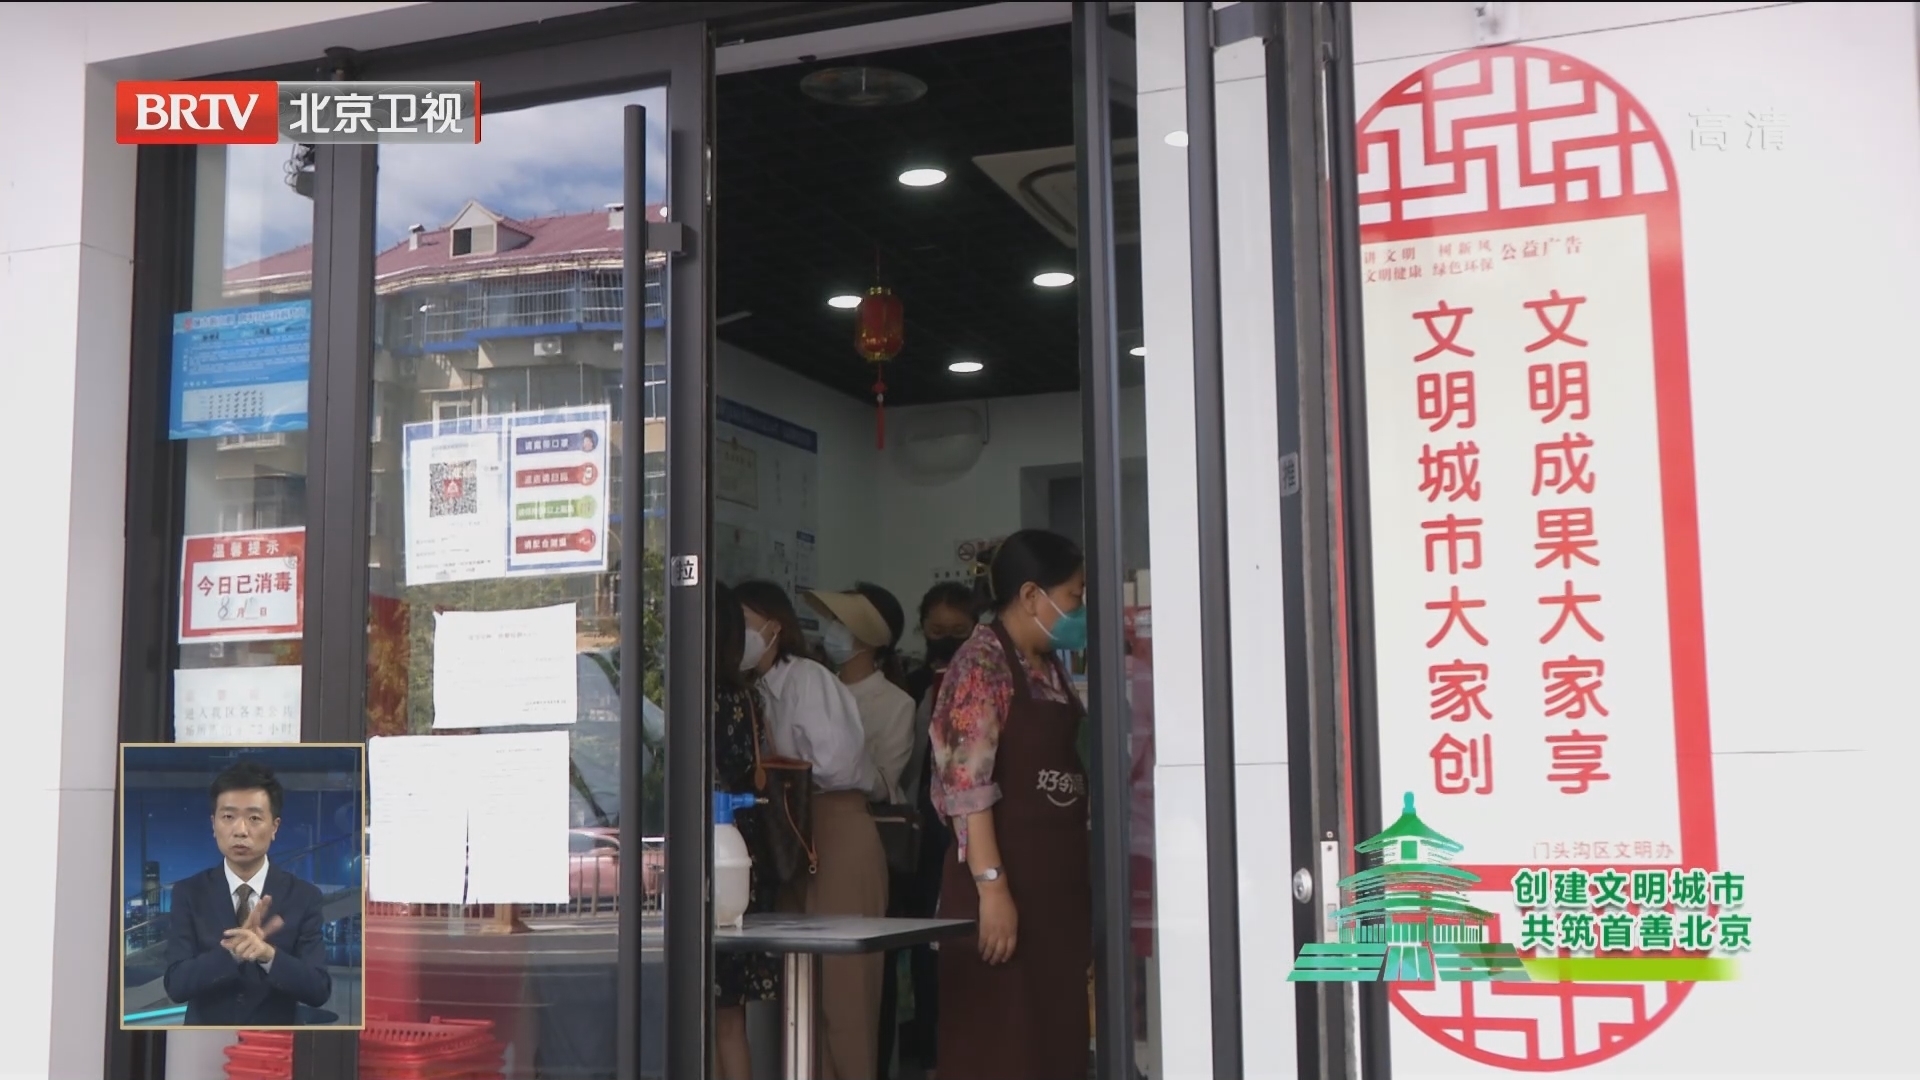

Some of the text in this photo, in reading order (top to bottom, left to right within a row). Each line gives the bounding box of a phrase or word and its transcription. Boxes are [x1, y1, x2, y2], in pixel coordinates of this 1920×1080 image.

[1364, 249, 1416, 265] 讲文明
[1501, 235, 1583, 260] 公益广告
[1364, 258, 1495, 282] 文明健康 绿色环保
[212, 541, 280, 557] 温馨提示
[1412, 301, 1495, 796] 文明城市大家创
[1524, 290, 1611, 795] 文明成果大家享
[676, 560, 695, 581] 拉
[197, 572, 293, 596] 今日已消毒
[1533, 842, 1675, 860] 门头沟区文明办
